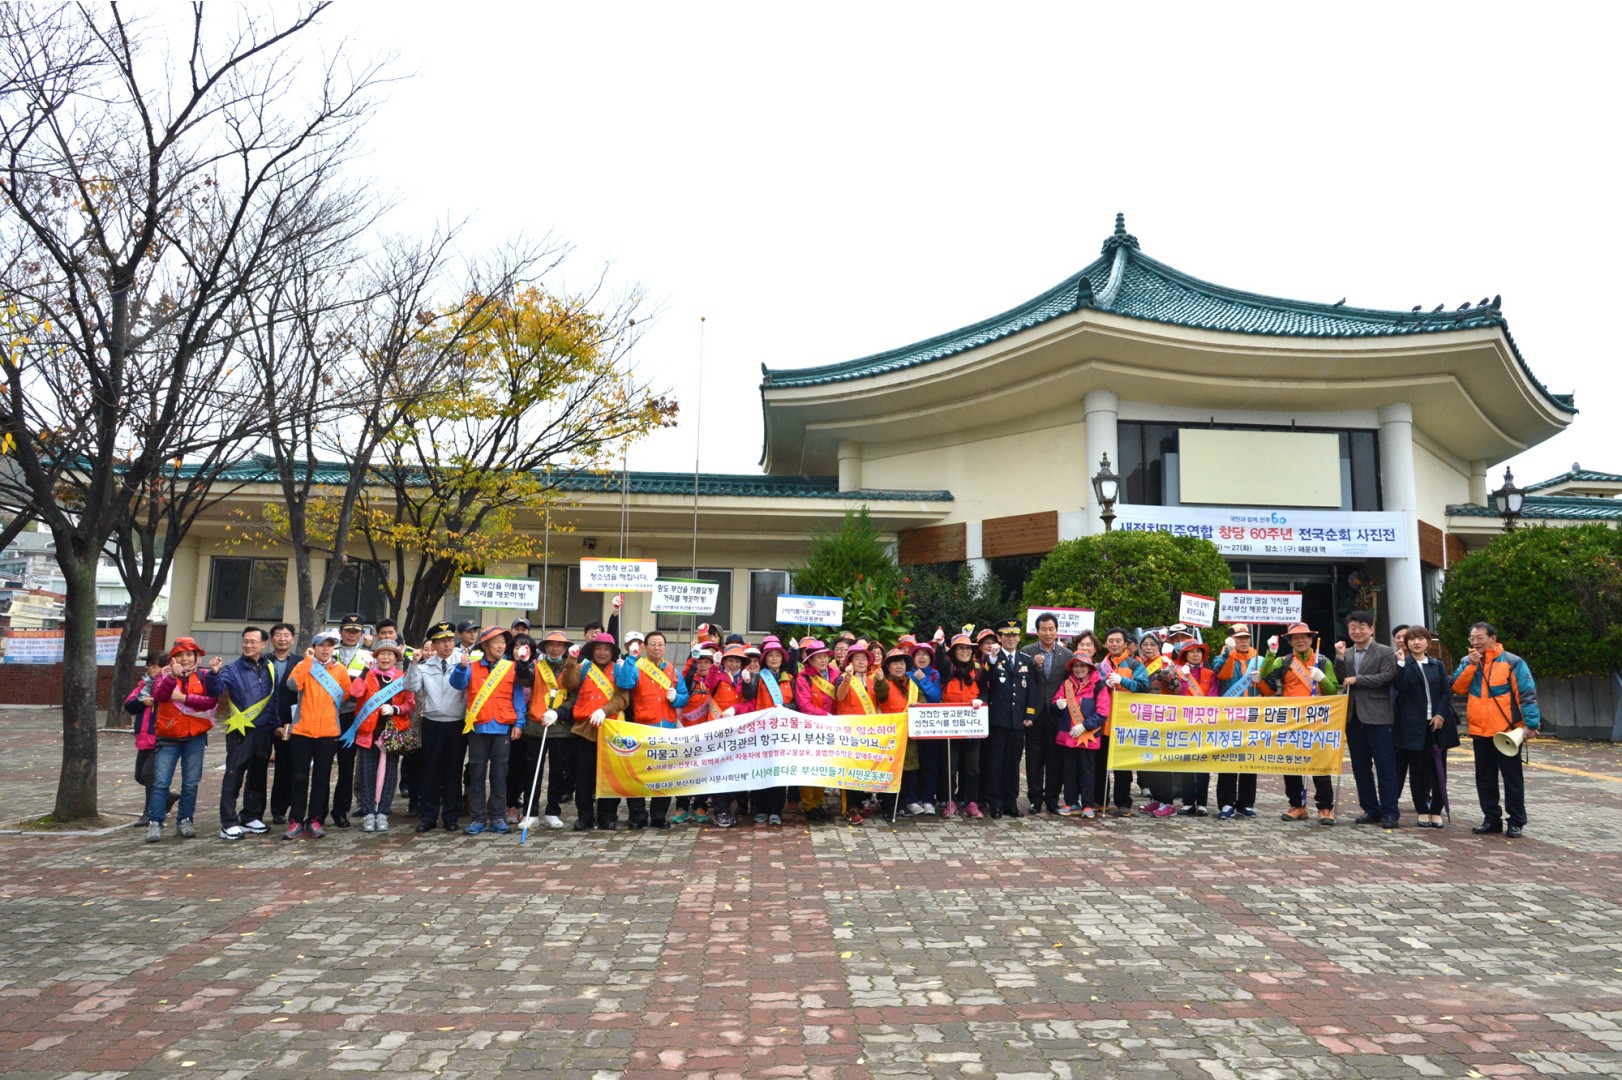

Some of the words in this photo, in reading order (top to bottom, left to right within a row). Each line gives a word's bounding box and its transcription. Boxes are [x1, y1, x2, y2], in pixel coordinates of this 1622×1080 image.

[1219, 526, 1245, 540] 창당
[1250, 527, 1293, 541] 60주년
[1298, 528, 1351, 541] 전국순회
[1356, 528, 1396, 542] 사진전
[1231, 544, 1253, 552] 27(화)
[1264, 545, 1279, 553] 장소
[1283, 545, 1296, 553] (구)
[481, 582, 502, 590] 부산을
[671, 585, 688, 594] 부산을
[473, 590, 493, 598] 거리를
[1233, 596, 1253, 605] 조금만
[1254, 597, 1268, 605] 관심
[1270, 597, 1289, 605] 가지면
[1220, 604, 1247, 613] 우리부산
[1249, 605, 1269, 613] 깨끗한
[1270, 606, 1284, 614] 부산
[919, 710, 940, 718] 건전한
[942, 709, 977, 718] 광고문화는
[1130, 703, 1177, 722] 아름답고
[1182, 706, 1219, 725] 깨끗한
[1223, 707, 1259, 724] 거리를
[1264, 707, 1301, 724] 만들기
[1305, 705, 1330, 724] 위해
[737, 718, 766, 735] 선정적
[1114, 727, 1160, 747] 게시물은
[1166, 730, 1201, 748] 반드시
[1247, 730, 1272, 747] 곳에
[1276, 730, 1341, 749] 부착합시다!
[646, 748, 679, 761] 머물고
[683, 745, 704, 758] 싶은
[706, 735, 757, 752] 도시경관의
[760, 732, 801, 748] 항구도시
[804, 732, 836, 746] 부산을
[1159, 753, 1208, 763] (사)아름다운
[1212, 753, 1255, 763] 부산만들기
[1259, 754, 1312, 764] 시민운동본부
[751, 765, 798, 779] (사)아름다운
[801, 765, 846, 778] 부산만들기
[847, 768, 894, 782] 시민운동본부
